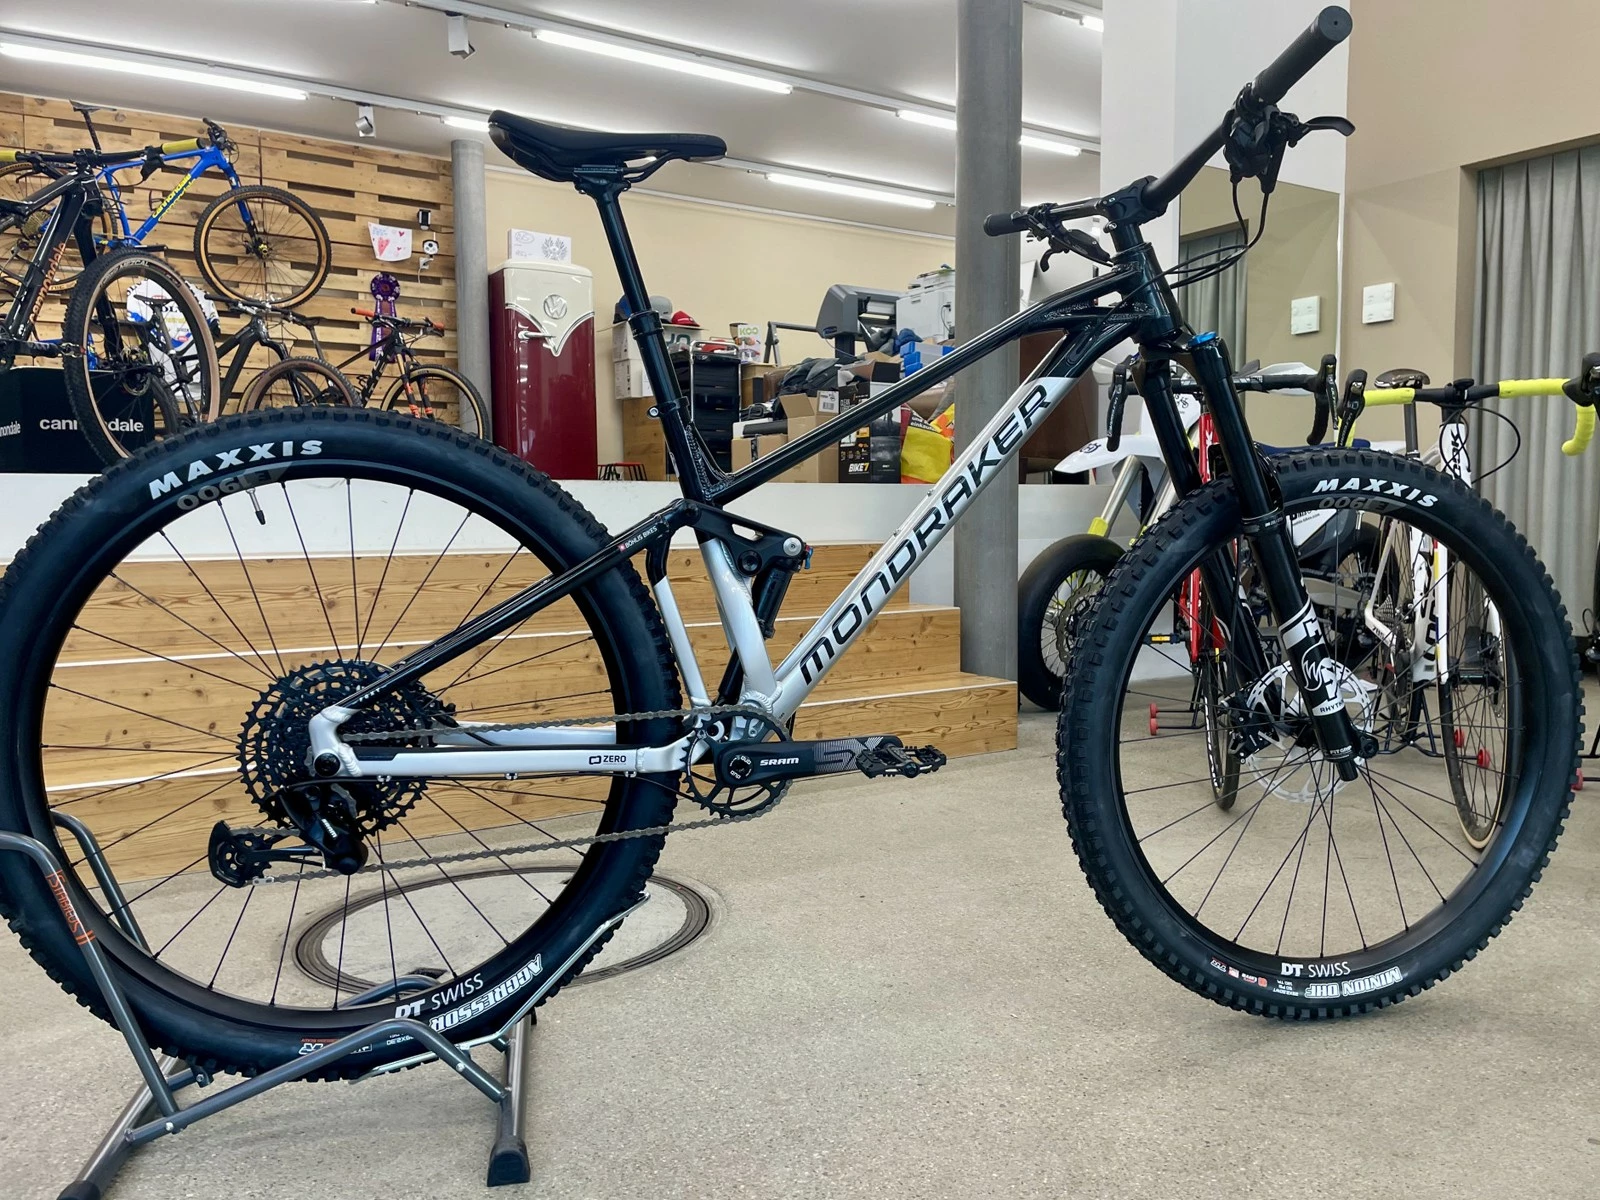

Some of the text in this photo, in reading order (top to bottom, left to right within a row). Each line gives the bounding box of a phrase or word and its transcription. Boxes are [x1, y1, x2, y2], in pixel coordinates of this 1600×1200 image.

[152, 173, 191, 218] cannondale
[28, 242, 65, 323] cannondale
[739, 326, 759, 336] KOO
[39, 417, 145, 432] candale
[149, 440, 323, 501] MAXXIS
[848, 462, 869, 473] BIKE7
[1312, 478, 1438, 507] MAXXIS
[642, 525, 658, 538] BIKES
[799, 384, 1052, 686] MONDRAKER
[359, 687, 380, 702] FOXY
[603, 755, 627, 764] ZERO
[759, 757, 799, 767] SRAM
[1280, 961, 1351, 978] DT SWISS
[429, 953, 543, 1033] AGGRESSOR
[1304, 966, 1404, 999] MINION DHF
[395, 973, 485, 1020] DT SWISS
